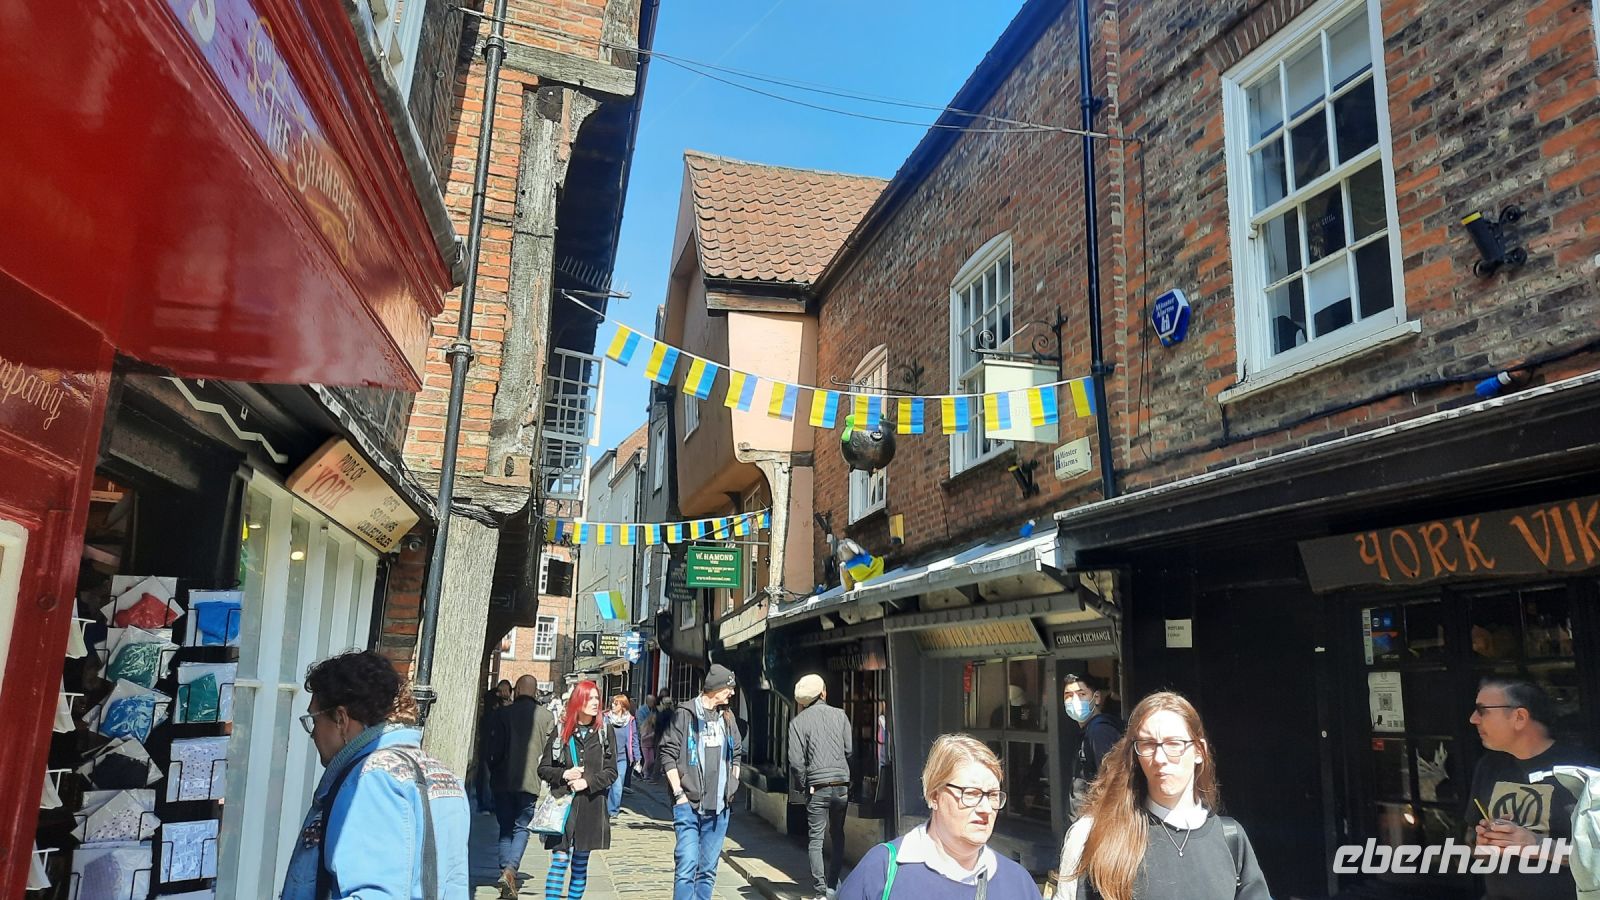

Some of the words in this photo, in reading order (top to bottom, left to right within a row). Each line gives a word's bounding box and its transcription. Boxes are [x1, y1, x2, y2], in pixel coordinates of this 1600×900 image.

[256, 41, 273, 65] ON
[263, 79, 293, 163] THE
[296, 130, 357, 242] SHAMBLES
[1155, 297, 1175, 311] Minster
[1156, 305, 1175, 319] Alarms
[1060, 449, 1078, 459] Minster
[336, 453, 361, 477] PRIDE
[349, 466, 367, 482] OF
[1060, 459, 1079, 469] Alarms
[303, 465, 354, 512] YORK
[1354, 517, 1496, 581] YORK
[704, 553, 734, 561] HAMOND
[1056, 632, 1084, 645] CURRENCY
[1083, 630, 1111, 643] EXCHANGE
